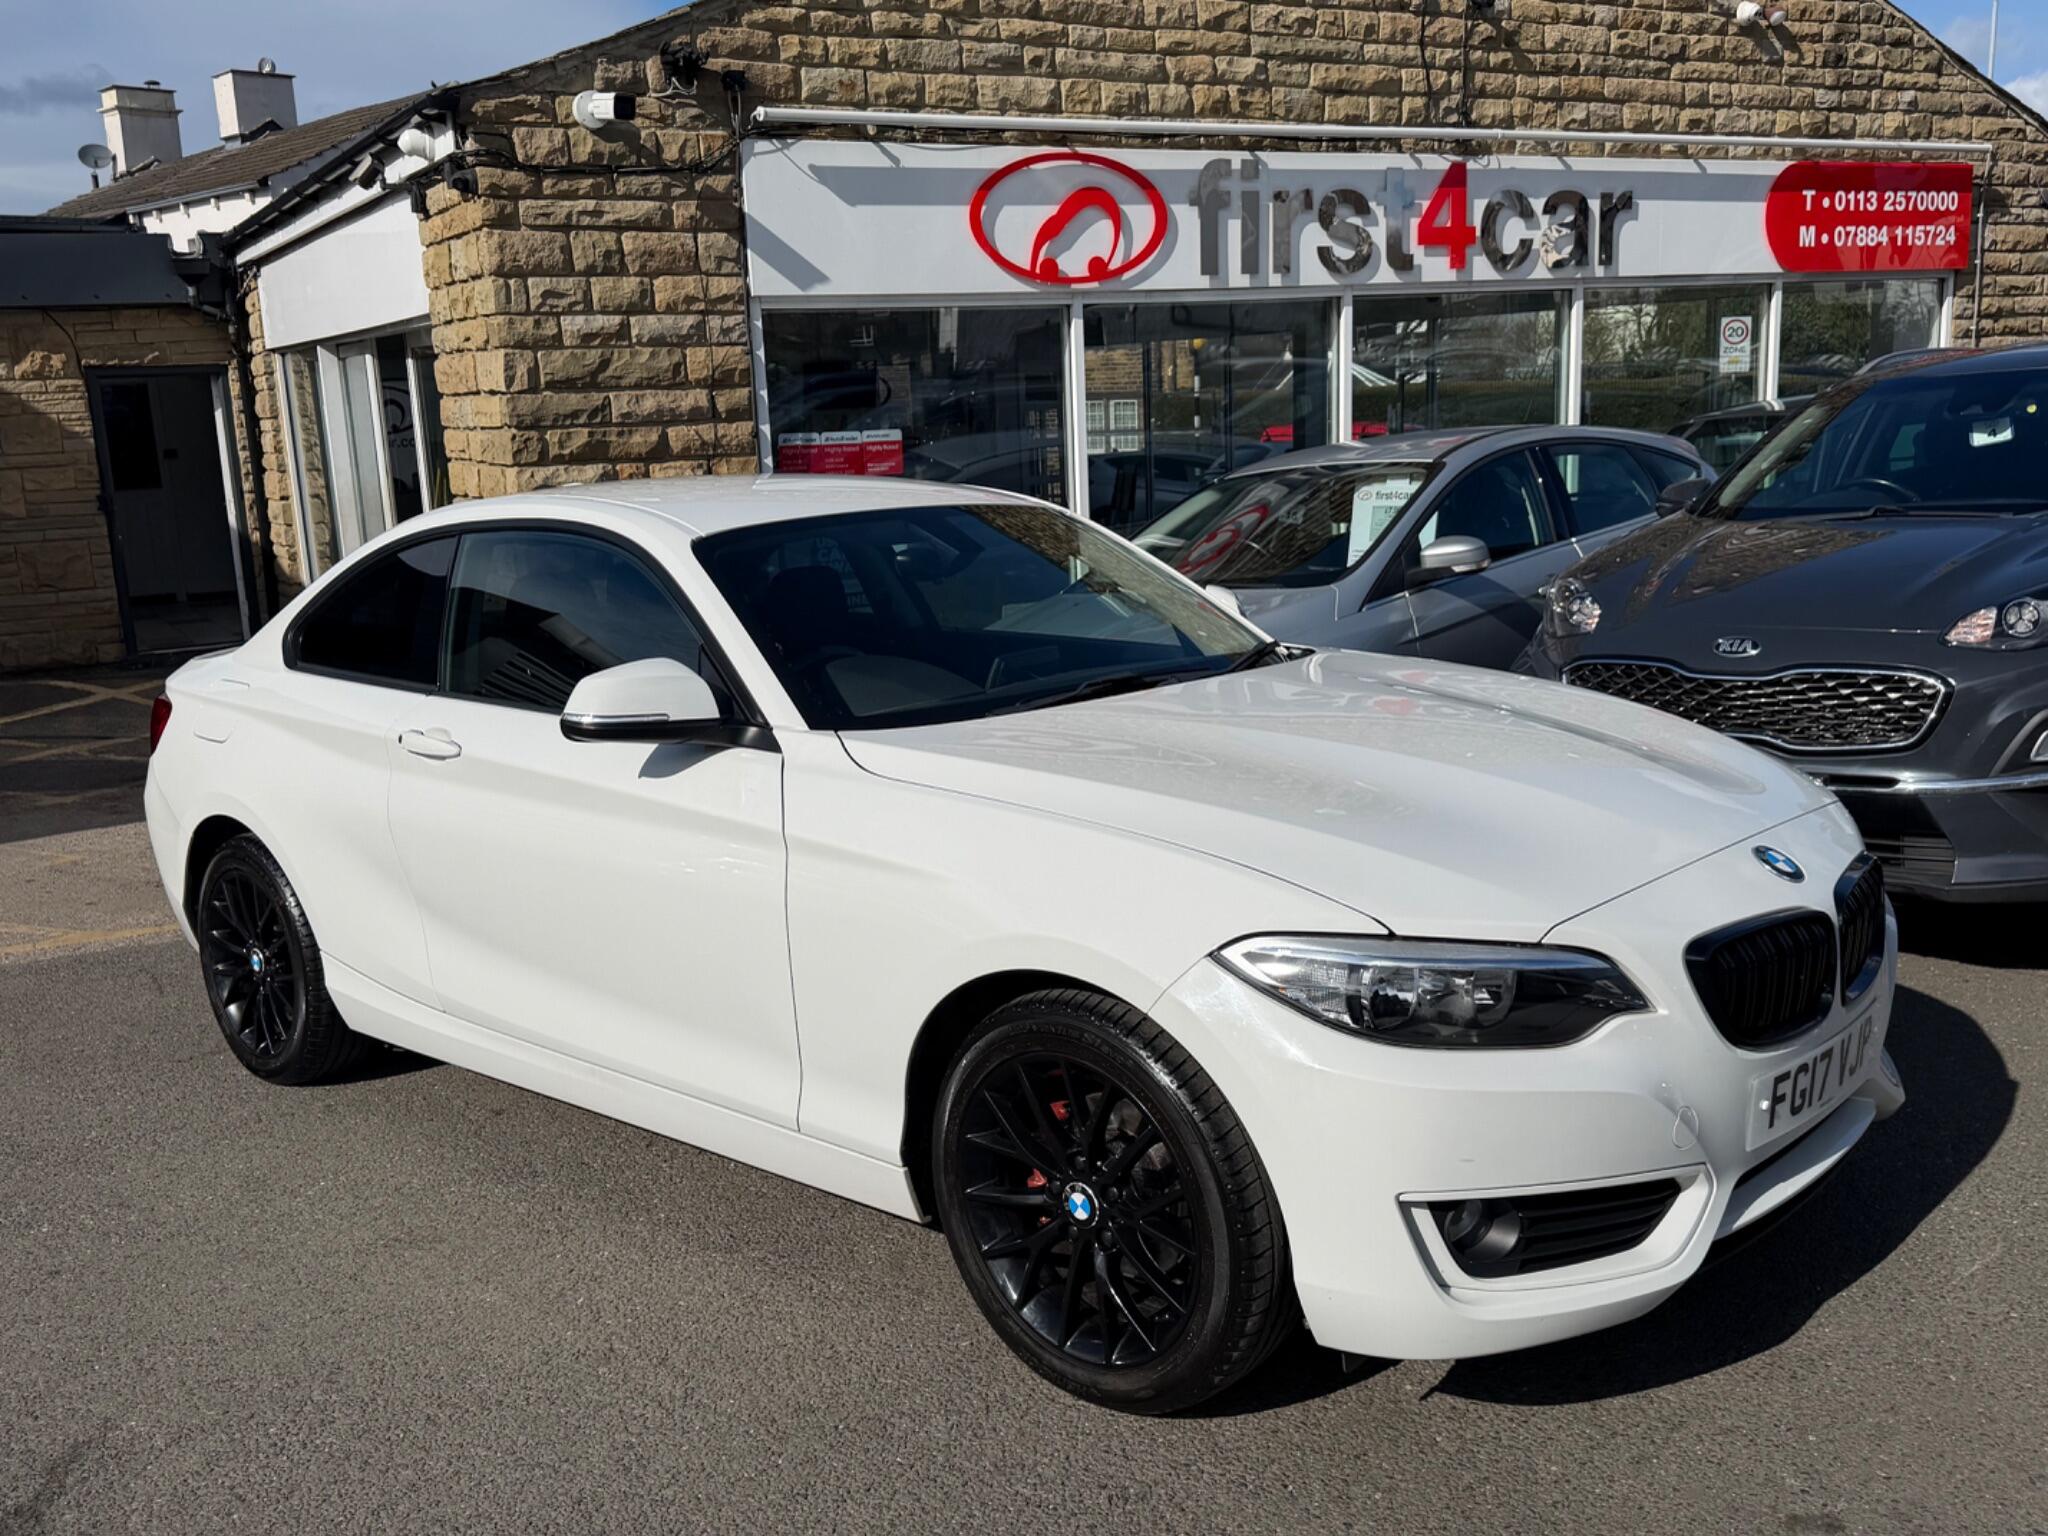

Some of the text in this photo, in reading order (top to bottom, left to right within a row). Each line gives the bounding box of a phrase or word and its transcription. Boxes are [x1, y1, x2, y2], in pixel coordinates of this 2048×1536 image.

[1802, 189, 1959, 212] T 0113 2570000
[1188, 158, 1632, 275] first4car
[1799, 225, 1957, 247] M 07884 115724
[1727, 326, 1745, 338] 20
[1723, 346, 1746, 354] ZONE
[1375, 490, 1411, 501] first4ca
[1718, 639, 1752, 652] KIA
[1768, 1015, 1873, 1129] FG17 VJP
